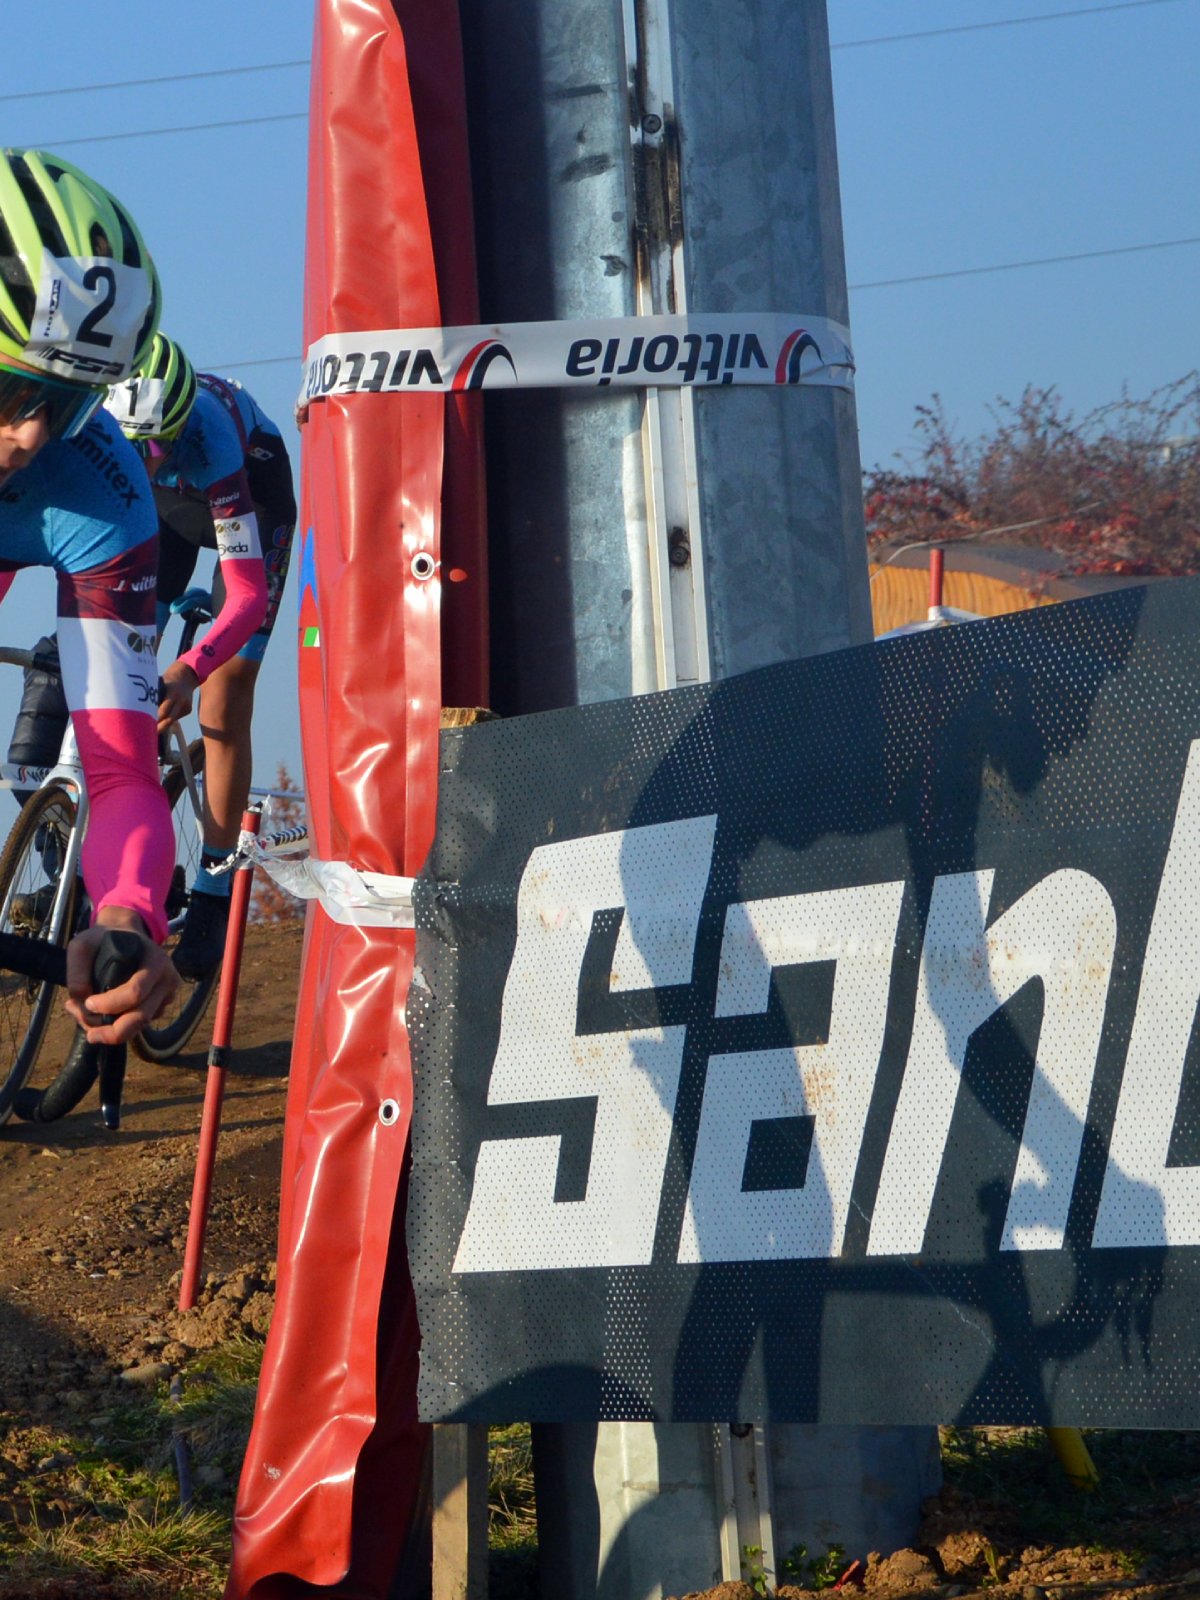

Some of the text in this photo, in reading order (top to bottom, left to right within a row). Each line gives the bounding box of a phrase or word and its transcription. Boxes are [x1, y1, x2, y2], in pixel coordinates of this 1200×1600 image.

[75, 265, 116, 348] 2
[566, 333, 769, 386] vittoria
[125, 381, 139, 417] 1
